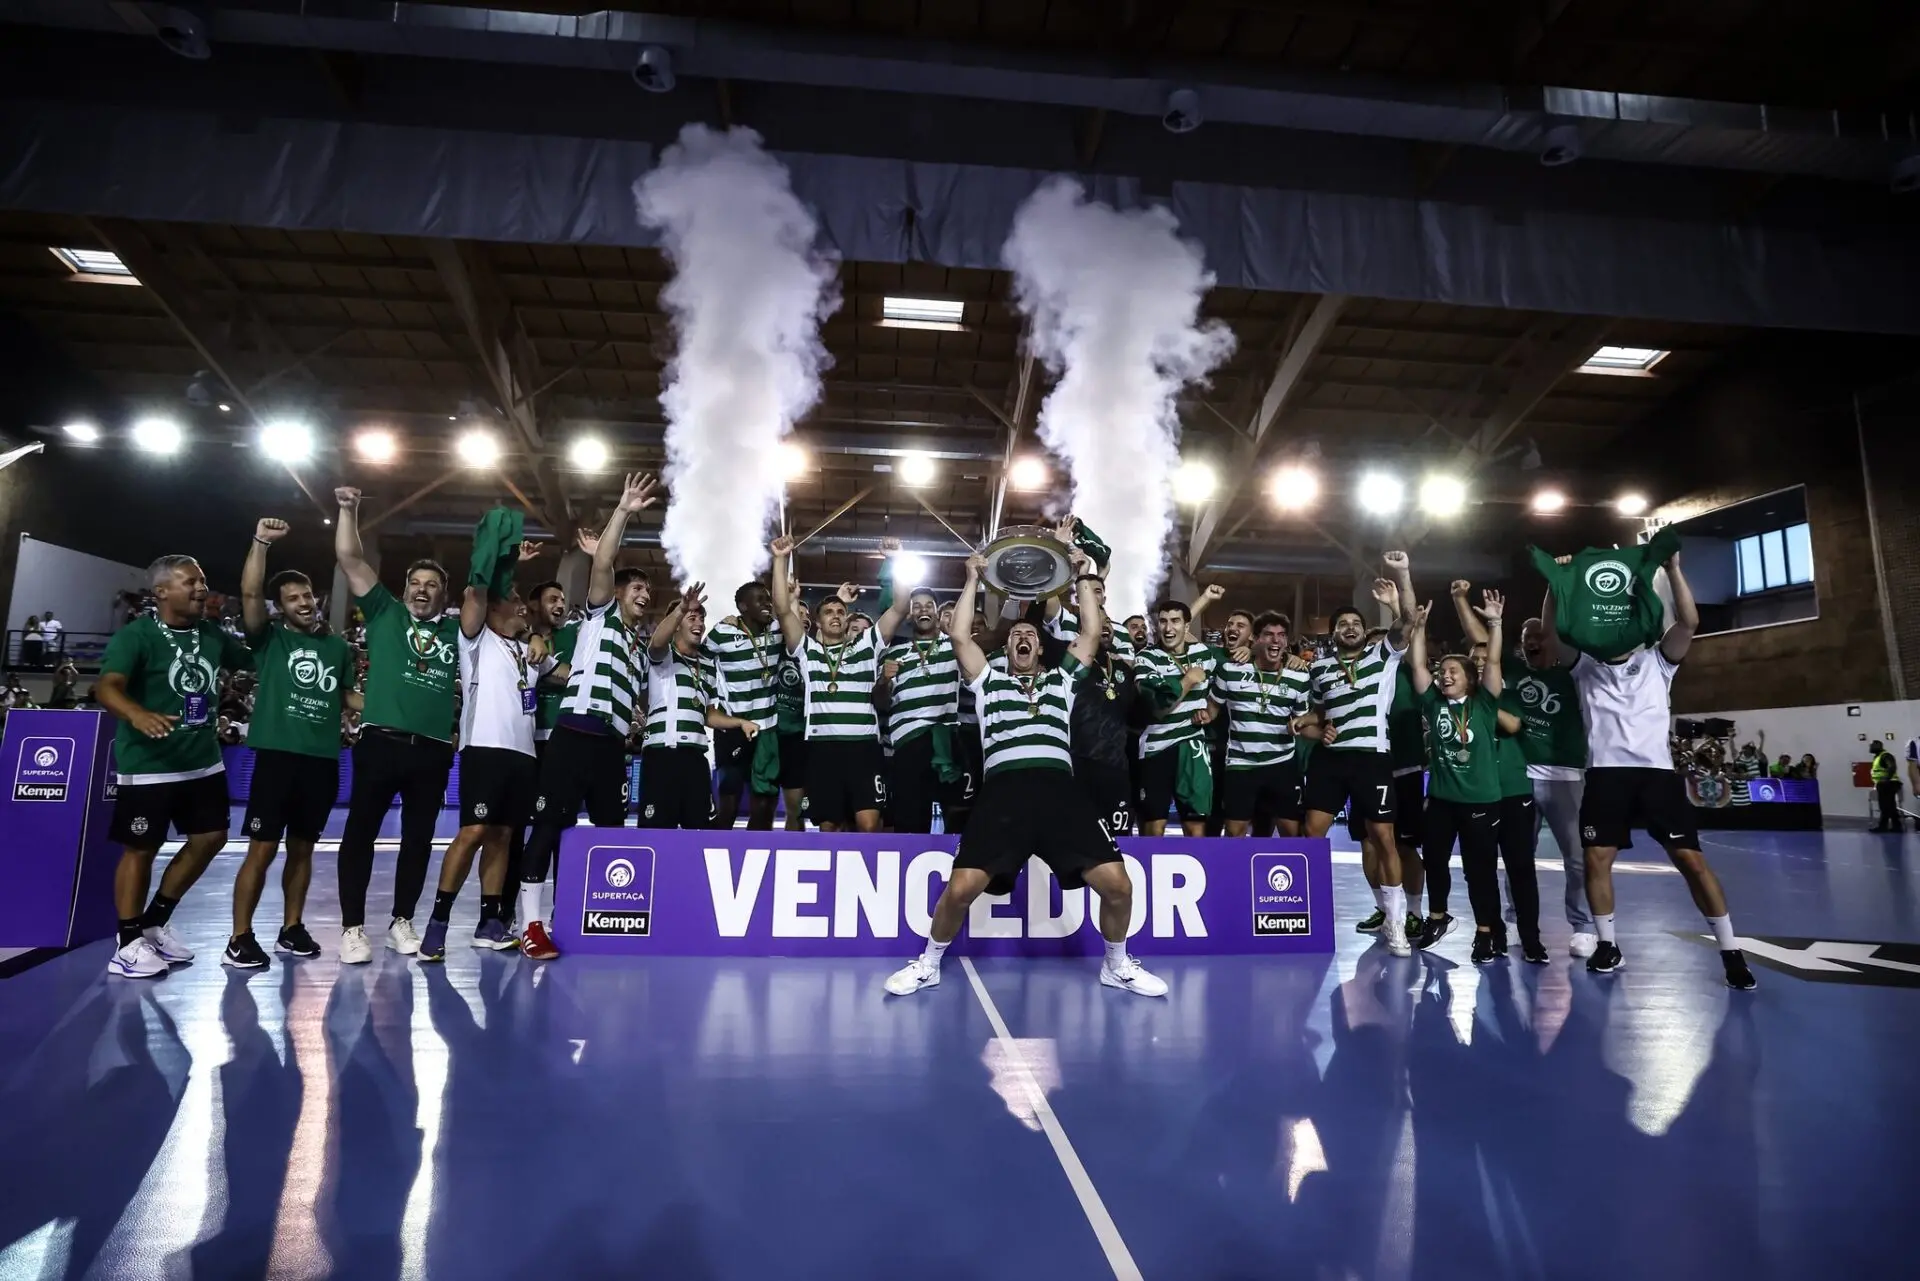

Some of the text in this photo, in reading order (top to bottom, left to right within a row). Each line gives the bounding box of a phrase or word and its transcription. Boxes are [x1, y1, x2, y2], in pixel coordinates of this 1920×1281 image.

[17, 785, 64, 799] Kempa
[1376, 785, 1388, 806] 7
[1112, 811, 1129, 830] 92
[592, 892, 645, 901] SUPERTAÇA
[587, 912, 646, 932] Kempa
[1257, 915, 1306, 932] Kempa
